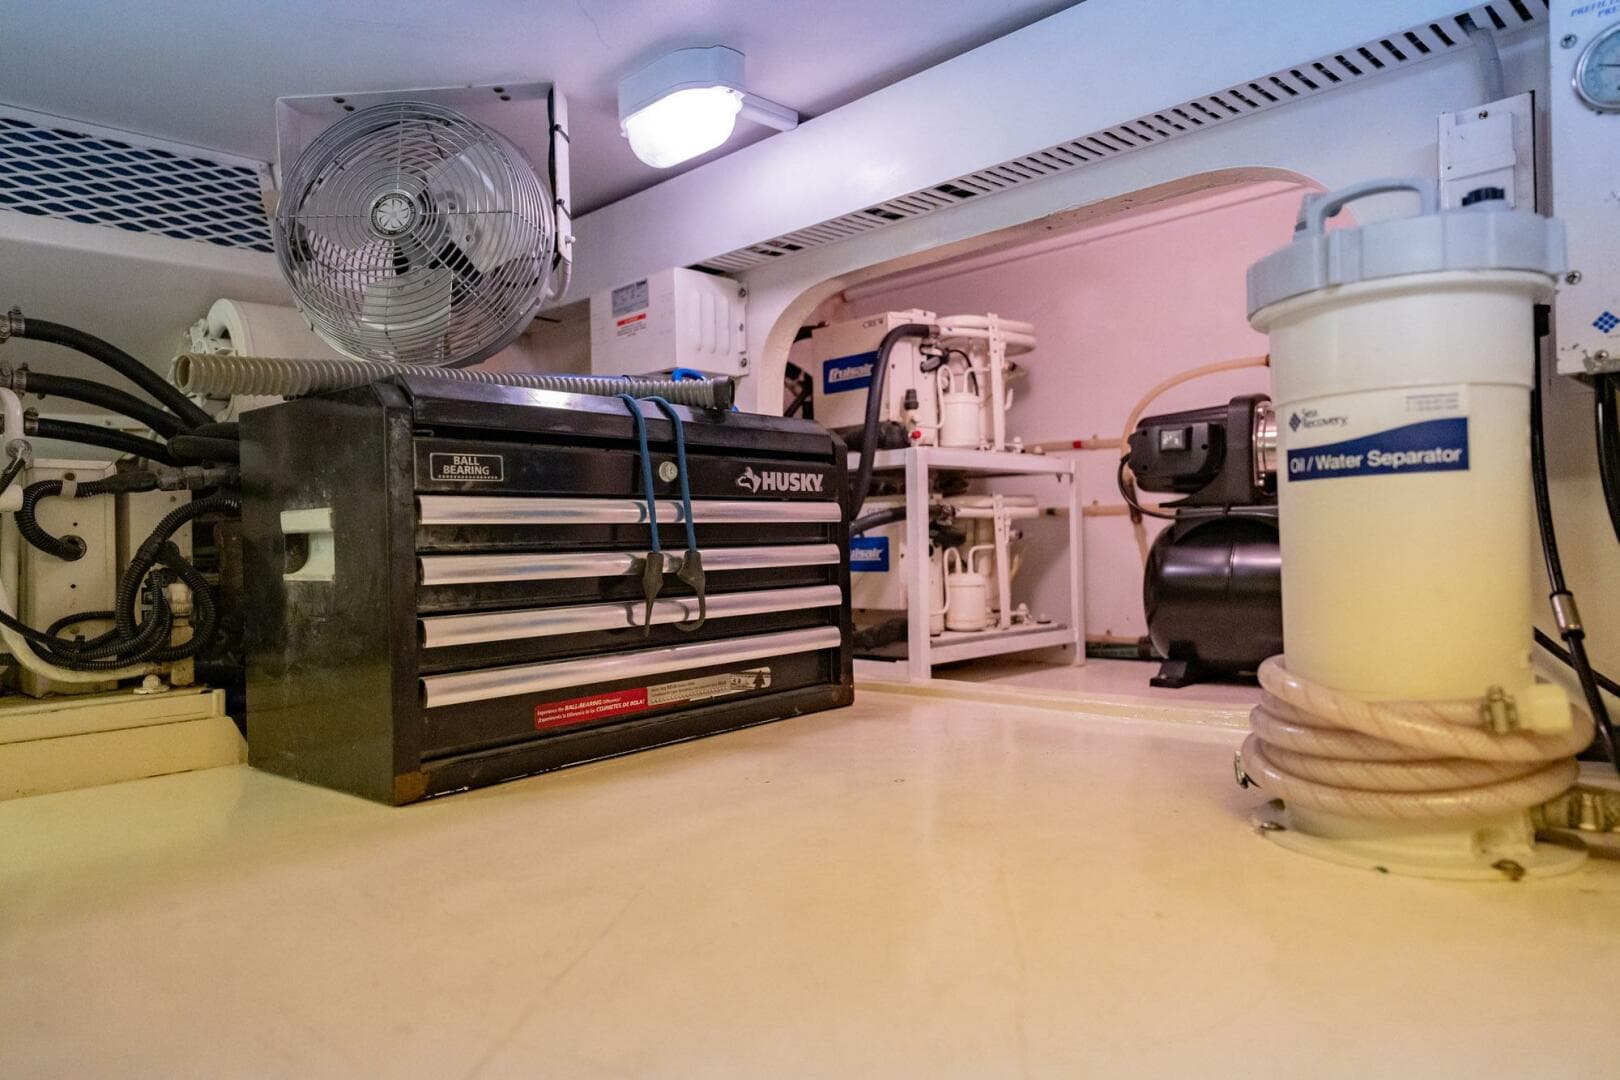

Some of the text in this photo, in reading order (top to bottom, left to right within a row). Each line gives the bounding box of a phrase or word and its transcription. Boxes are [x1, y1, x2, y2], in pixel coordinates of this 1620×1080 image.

[453, 455, 480, 466] BALL
[1314, 454, 1364, 471] Water
[1366, 447, 1463, 470] Separator
[442, 465, 490, 475] BEARING
[762, 471, 824, 492] HUSKY
